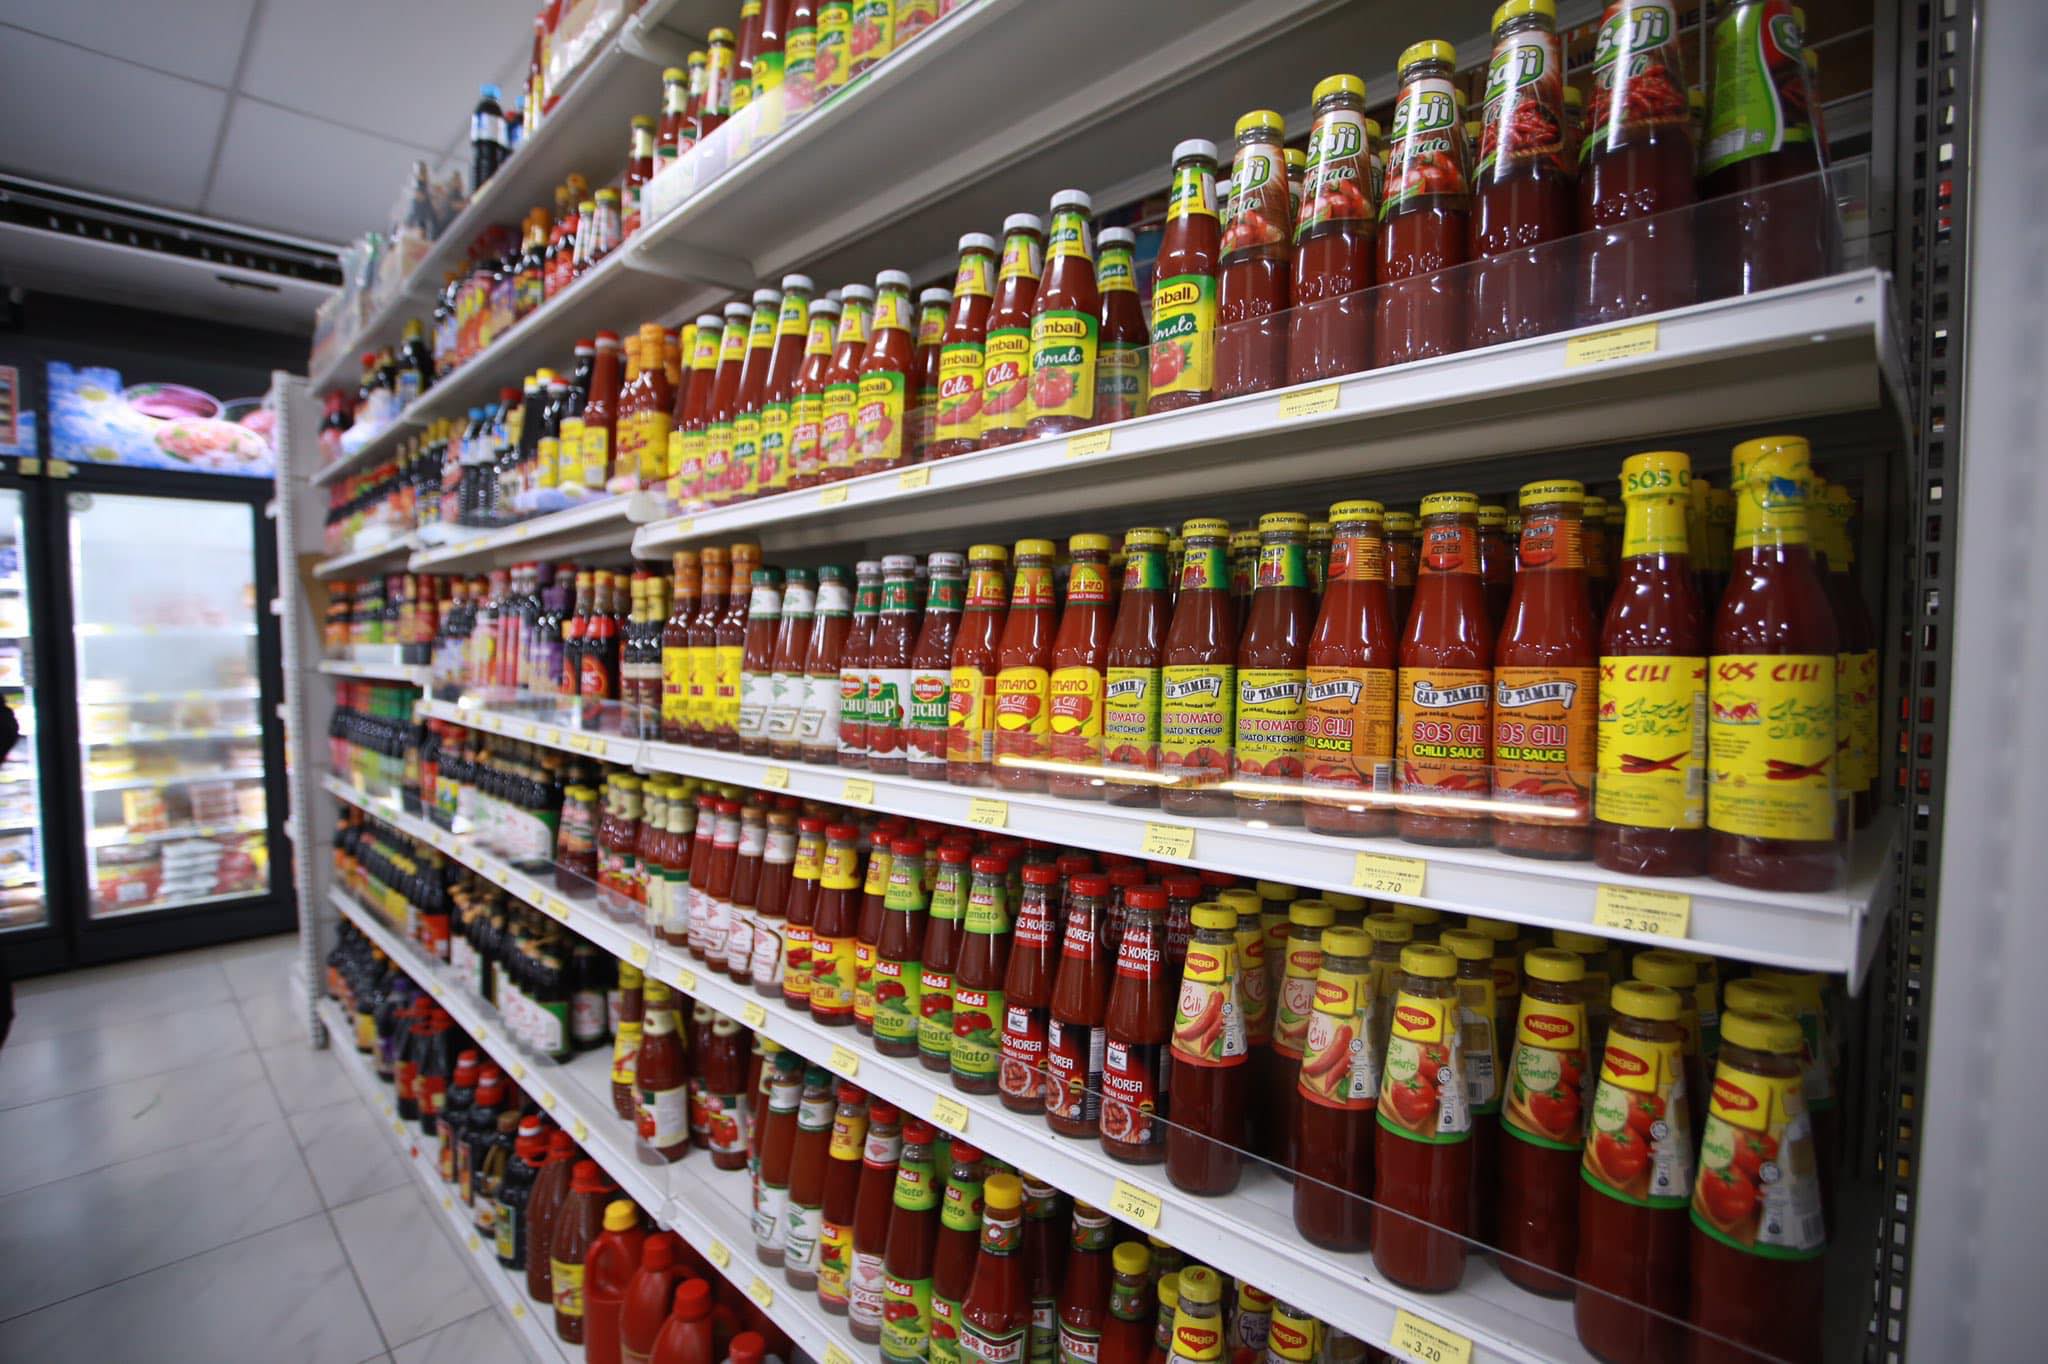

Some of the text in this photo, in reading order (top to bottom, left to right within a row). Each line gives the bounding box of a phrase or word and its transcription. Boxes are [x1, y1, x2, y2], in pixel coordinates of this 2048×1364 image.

[1034, 347, 1081, 368] Tomato
[987, 362, 1014, 386] Cili
[942, 376, 969, 398] Cili
[1628, 468, 1672, 490] SOS
[1625, 664, 1671, 682] CILI
[1717, 662, 1759, 684] SOS
[1770, 662, 1820, 683] CILI
[1258, 684, 1295, 701] TAMIN
[1315, 682, 1349, 698] TAMIN
[1416, 685, 1486, 705] CAP TAMIN
[1516, 683, 1561, 702] TAMIN
[1011, 694, 1027, 706] Cili
[911, 703, 947, 717] ETCHU
[1109, 712, 1146, 724] TOMATO
[1177, 712, 1223, 724] TOMATO
[1185, 726, 1223, 737] KETCHUP
[1256, 719, 1305, 732] TOMATO
[1323, 717, 1353, 738] CILI
[1413, 721, 1452, 743] SOS
[1498, 722, 1567, 746] OS CILI
[1317, 739, 1352, 752] SAUCE
[1413, 744, 1448, 758] CHILLI
[1522, 749, 1567, 762] SAUCE
[1156, 845, 1177, 857] 2.70
[1375, 879, 1402, 893] 2.70
[1623, 917, 1659, 934] 2.30
[1128, 945, 1160, 962] KOREA
[1012, 1038, 1042, 1052] KOREA
[1519, 1062, 1558, 1081] Tomato
[1112, 1077, 1143, 1094] KOREA
[1125, 1202, 1145, 1218] 3.40
[1414, 1341, 1441, 1363] 3.20
